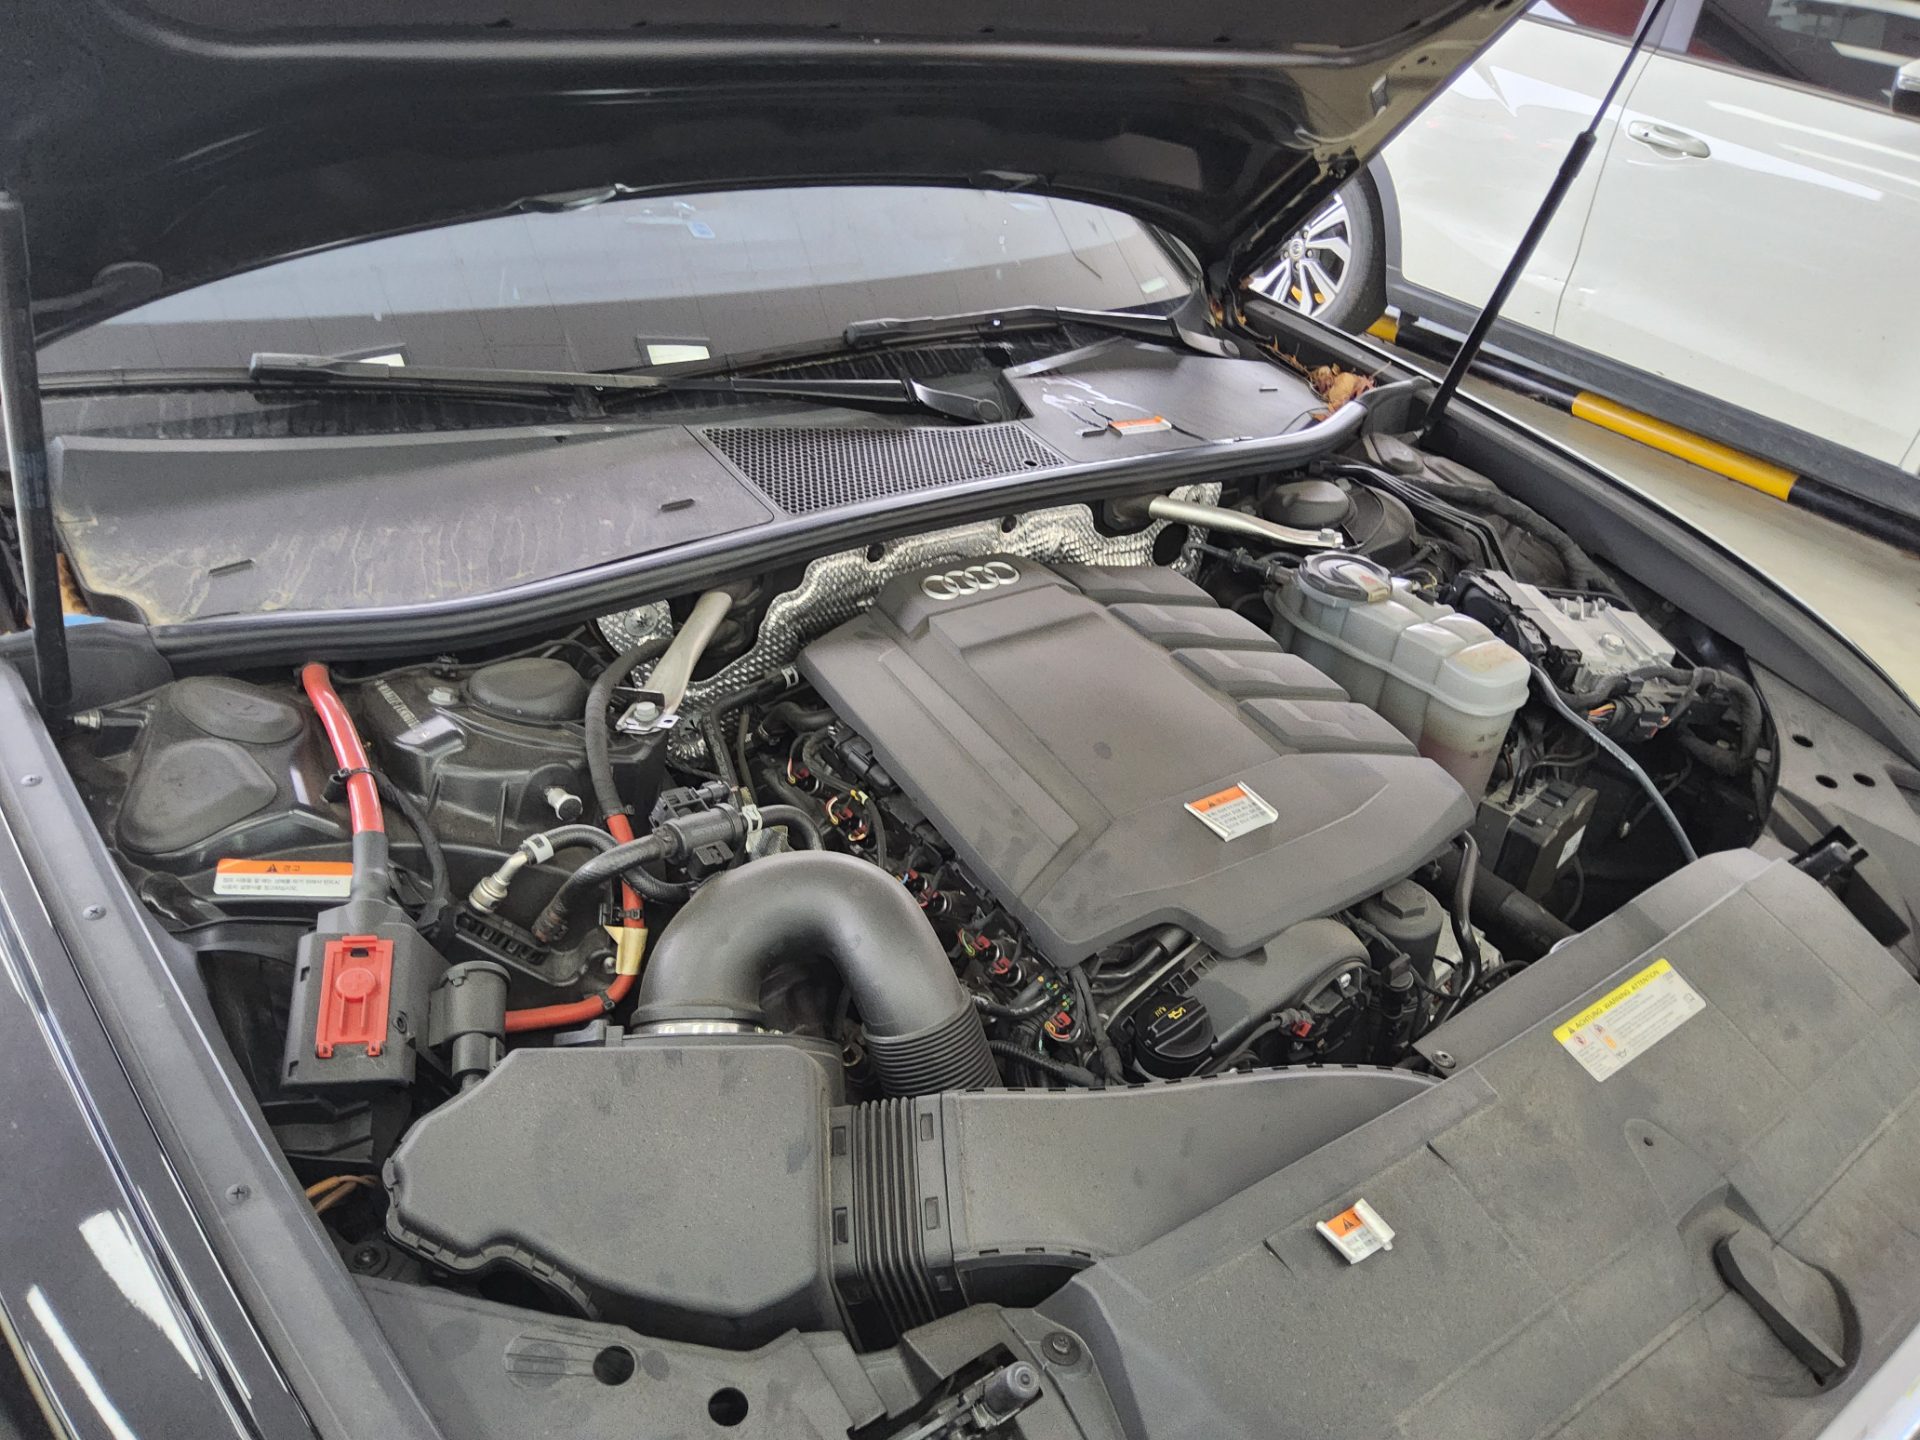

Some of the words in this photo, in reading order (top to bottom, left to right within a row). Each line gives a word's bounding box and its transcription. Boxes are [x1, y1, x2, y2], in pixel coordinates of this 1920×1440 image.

[1575, 1008, 1603, 1029] ACHTUNG
[1604, 989, 1631, 1010] WARNING
[1631, 970, 1660, 991] ATTENTION
